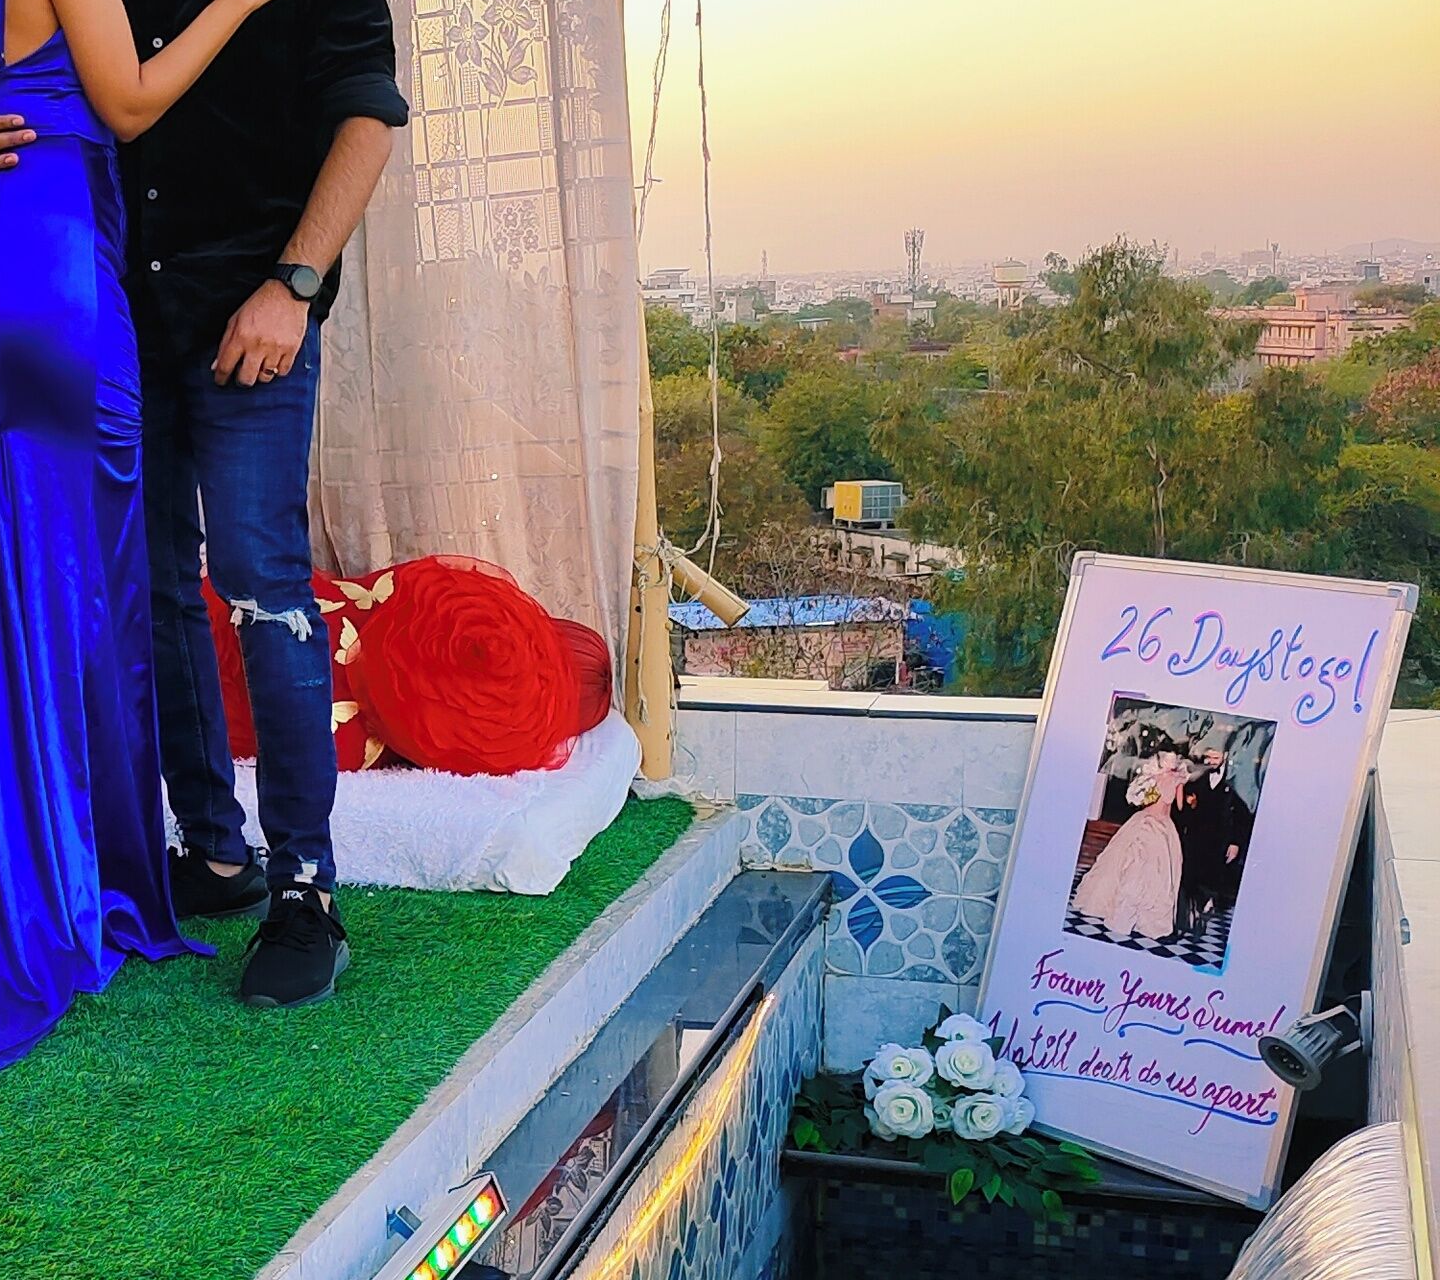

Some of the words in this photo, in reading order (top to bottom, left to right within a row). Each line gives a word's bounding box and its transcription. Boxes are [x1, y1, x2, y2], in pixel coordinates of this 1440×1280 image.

[1101, 605, 1173, 662] 26
[1281, 624, 1314, 681] to
[1294, 629, 1379, 724] go!
[1031, 948, 1106, 1004] Forever
[1104, 970, 1191, 1033] Yours
[988, 1010, 1077, 1071] Untill
[1079, 1047, 1132, 1082] death
[1138, 1060, 1161, 1086] do
[1166, 1071, 1197, 1097] us
[1188, 1082, 1277, 1135] apart
